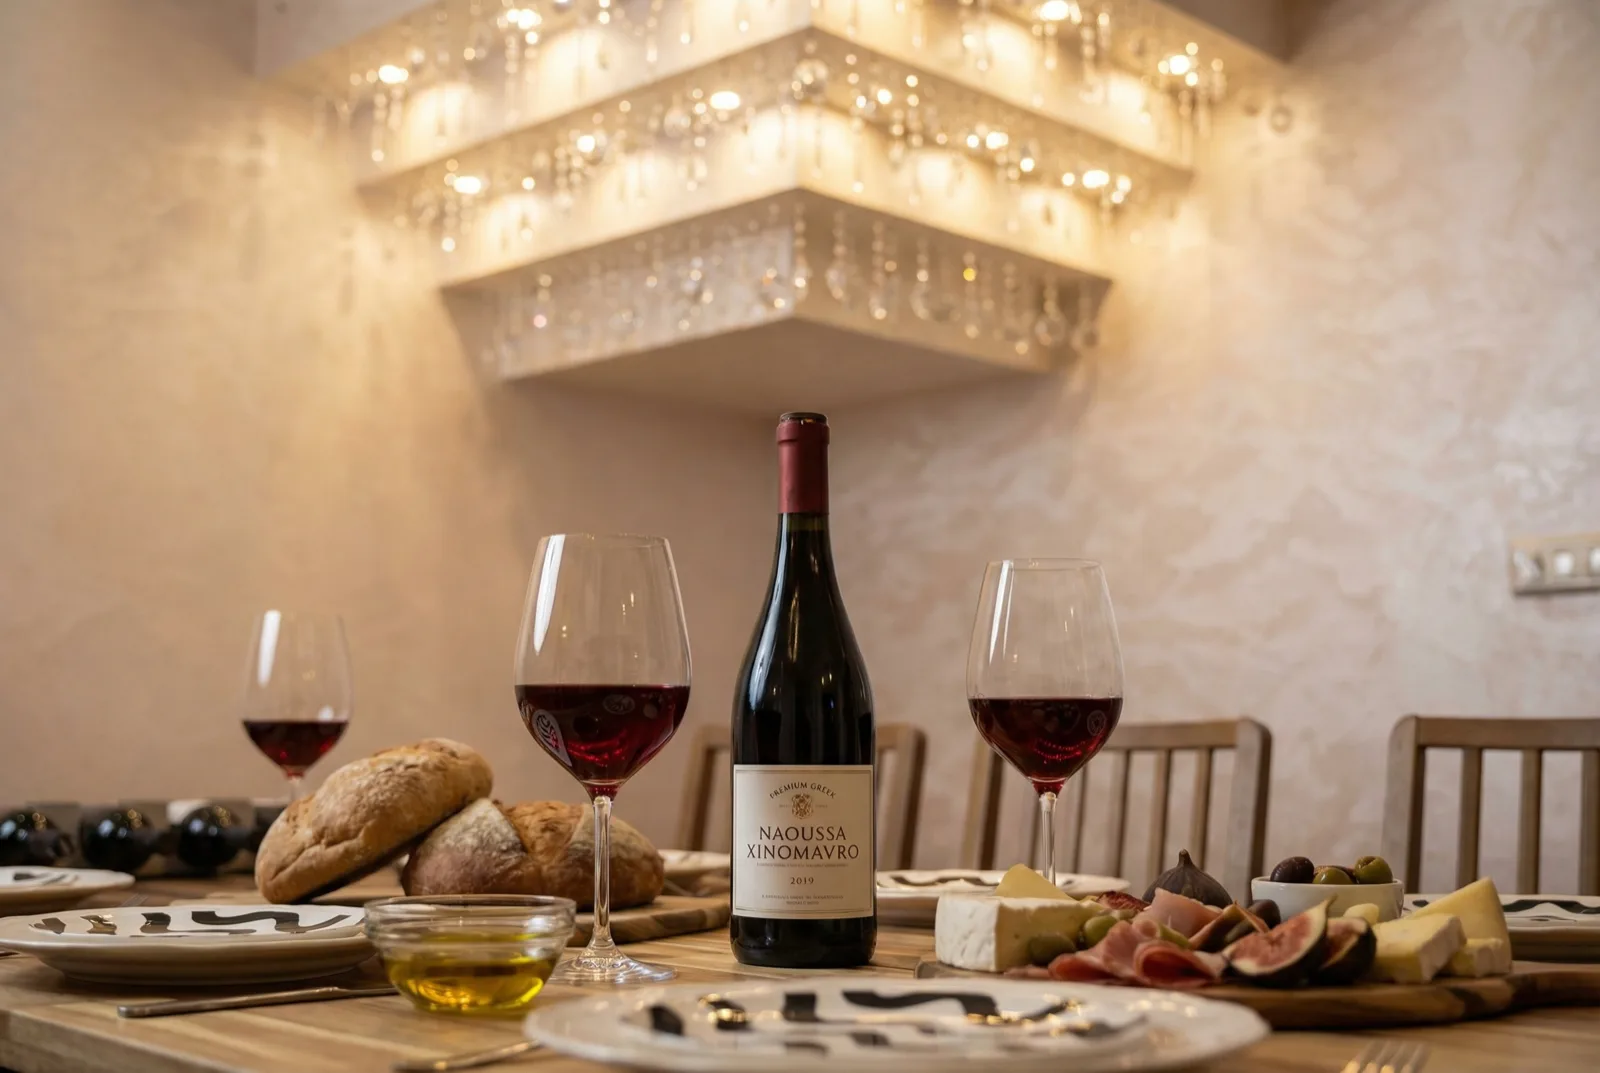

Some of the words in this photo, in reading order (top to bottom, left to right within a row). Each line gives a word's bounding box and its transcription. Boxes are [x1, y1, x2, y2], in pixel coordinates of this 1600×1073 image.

[769, 781, 808, 799] PREMIUM
[810, 782, 837, 799] GREEK
[759, 826, 847, 842] NAOUSSA
[747, 843, 859, 860] XINOMAVRO
[790, 876, 814, 885] 2019
